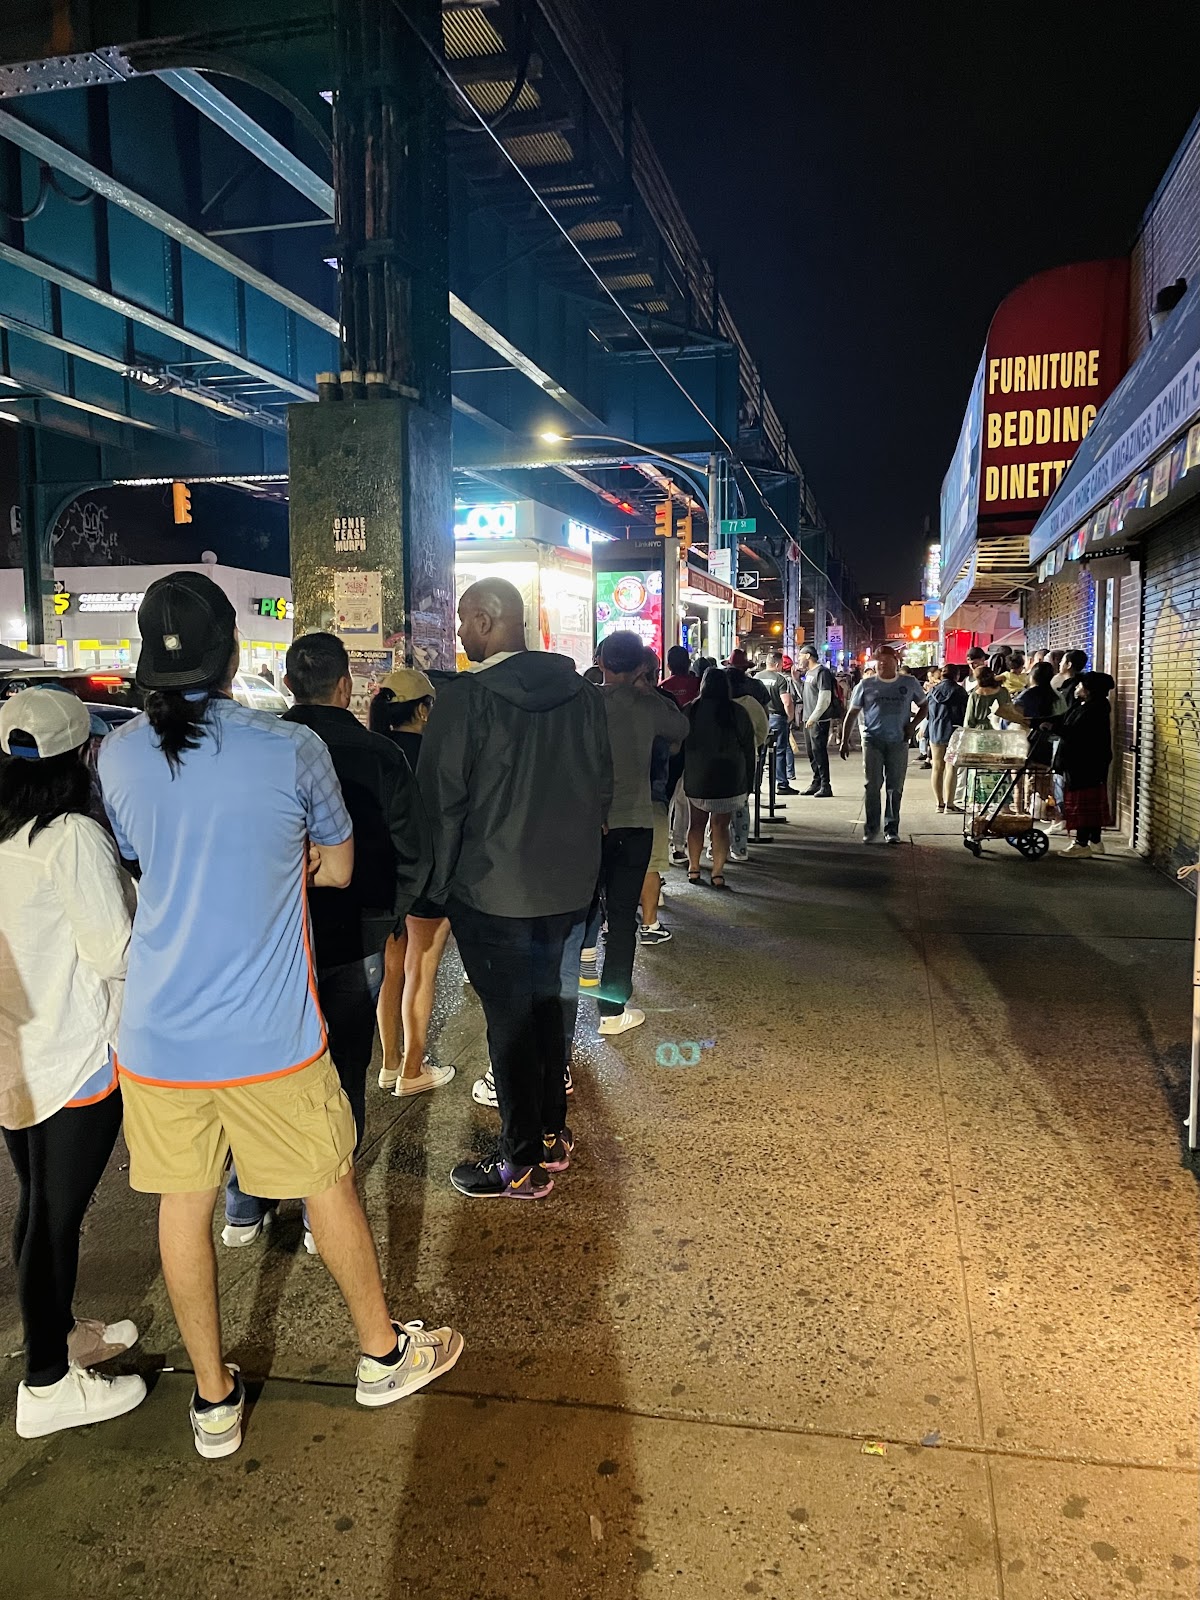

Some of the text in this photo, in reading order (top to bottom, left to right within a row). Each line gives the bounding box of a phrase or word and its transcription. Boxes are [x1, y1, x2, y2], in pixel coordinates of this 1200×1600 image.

[989, 350, 1099, 395] FURNITURE
[1155, 372, 1189, 439] DONUT,
[987, 404, 1097, 449] BEDDING
[985, 459, 1073, 502] DINETT
[334, 516, 366, 529] GENIE
[728, 521, 738, 532] 77
[335, 528, 367, 541] TEASE
[335, 540, 367, 552] MURPH
[120, 593, 145, 602] CAS
[830, 635, 842, 643] 25
